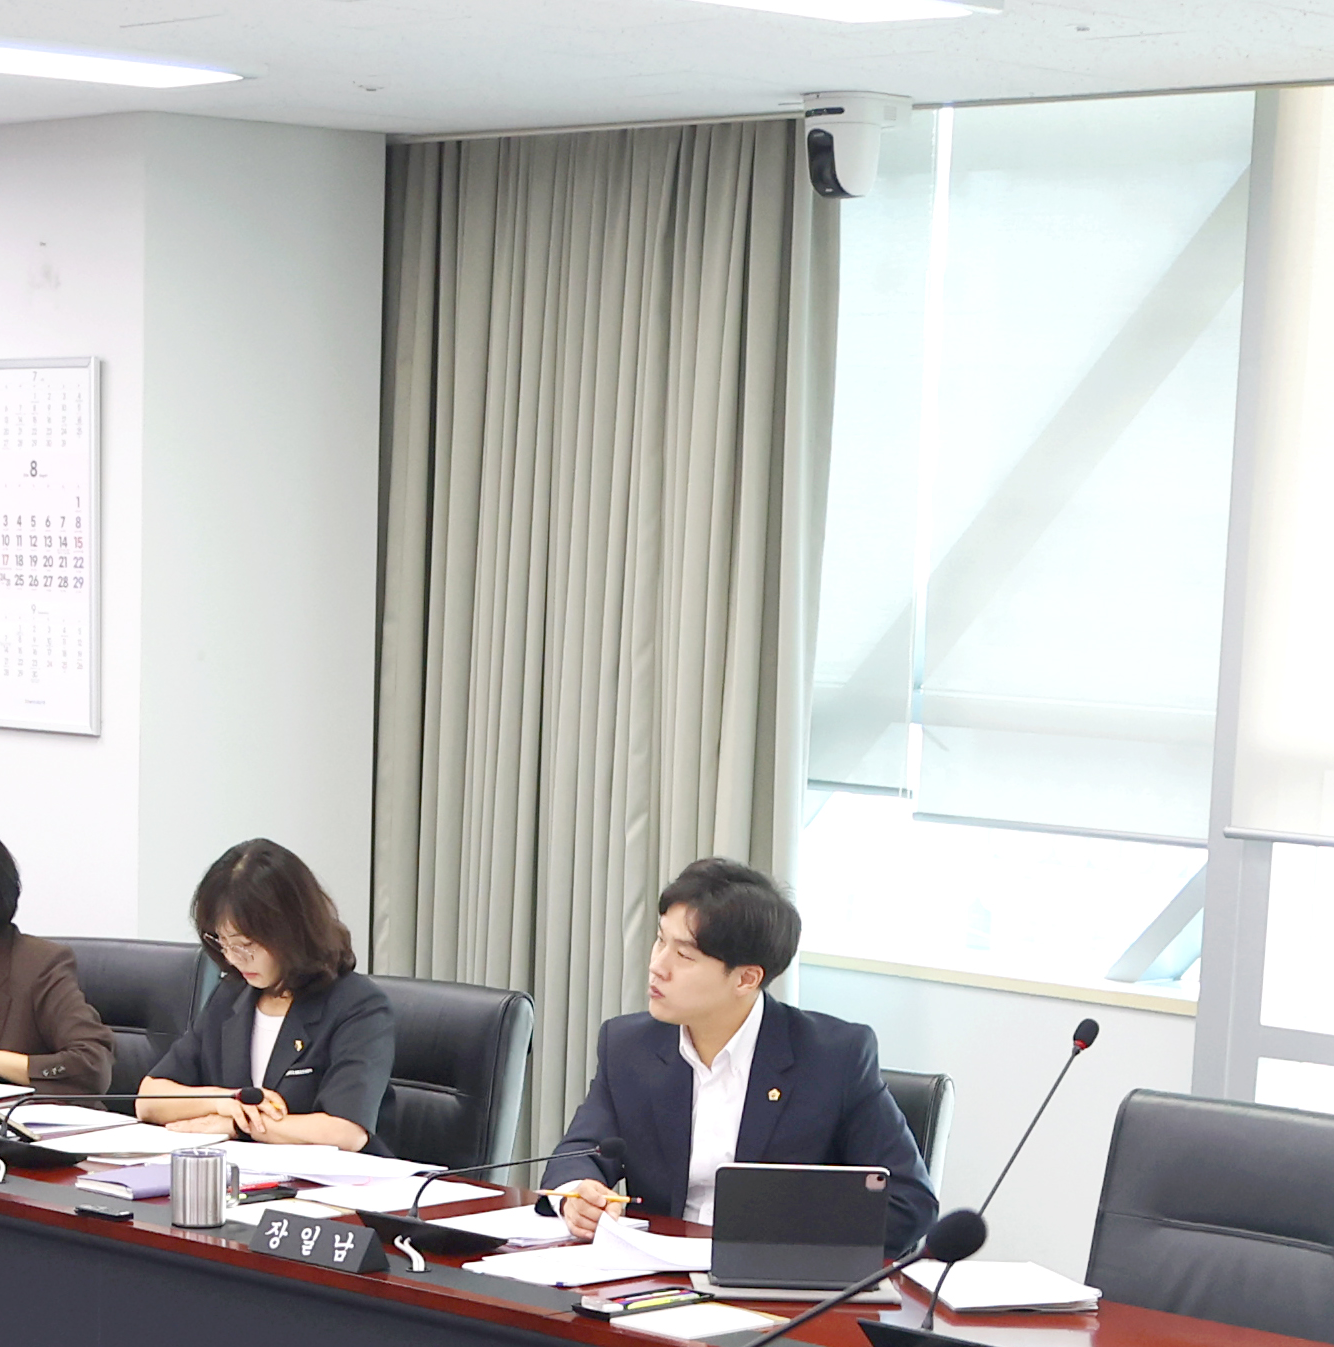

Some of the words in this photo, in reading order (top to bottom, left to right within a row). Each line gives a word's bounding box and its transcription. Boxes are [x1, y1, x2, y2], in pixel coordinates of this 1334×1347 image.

[29, 460, 38, 478] 8
[2, 514, 9, 528] 3
[16, 515, 23, 527] 4
[30, 515, 37, 528] 5
[44, 515, 52, 528] 6
[60, 515, 66, 528] 7
[75, 515, 82, 529] 8
[1, 534, 11, 547] 10
[15, 534, 23, 547] 11
[29, 534, 38, 548] 12
[43, 535, 53, 549] 13
[58, 535, 68, 548] 14
[73, 536, 84, 550] 15
[1, 553, 10, 566] 17
[29, 554, 39, 567] 19
[42, 555, 54, 568] 20
[58, 555, 68, 569] 21
[72, 556, 85, 569] 22
[14, 573, 25, 587] 25
[28, 574, 40, 588] 26
[43, 575, 54, 588] 27
[57, 575, 69, 589] 28
[72, 576, 85, 589] 29
[264, 1219, 354, 1262] 장일남
